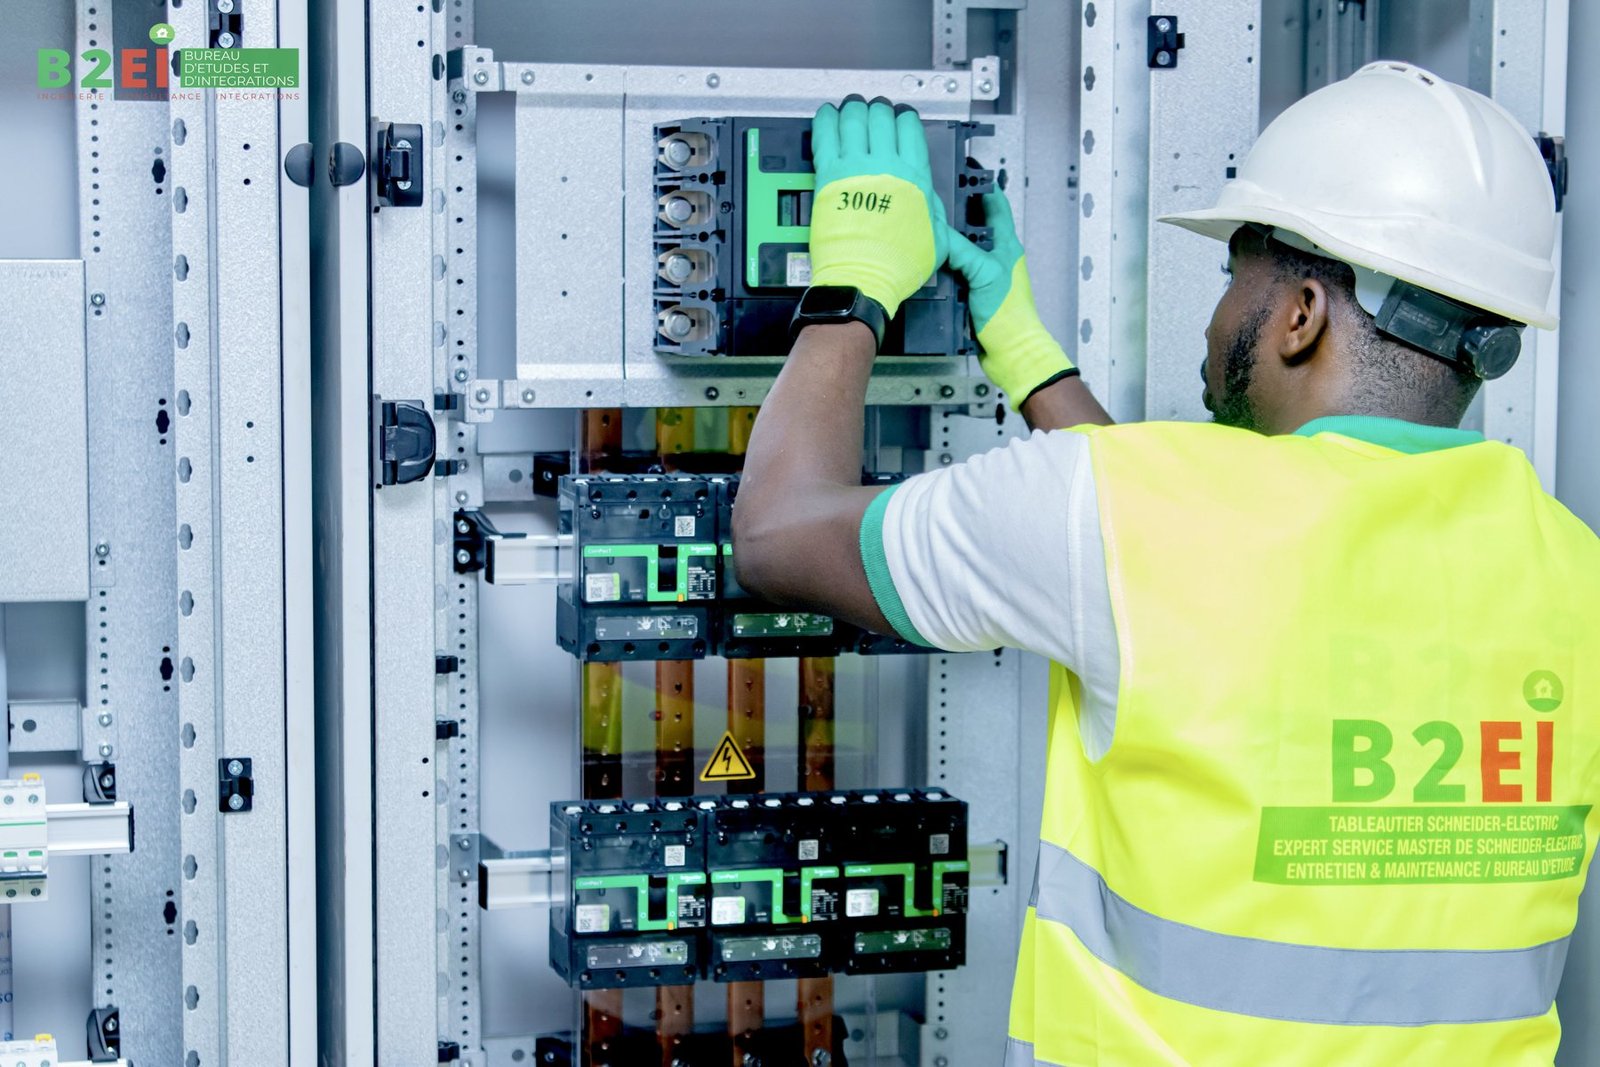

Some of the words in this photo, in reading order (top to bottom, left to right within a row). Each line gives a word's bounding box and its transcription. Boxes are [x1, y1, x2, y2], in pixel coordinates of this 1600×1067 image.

[837, 191, 892, 214] 300#
[1329, 816, 1423, 832] TABLEAUTIER
[1427, 815, 1559, 832] SCHNEIDER-ELECTRIC
[1273, 839, 1328, 856] EXPERT
[1332, 839, 1393, 856] SERVICE
[1397, 838, 1451, 856] MASTER
[1455, 838, 1473, 855] DE
[1476, 834, 1584, 855] SCHNEIDER-ELECTRIC
[1286, 862, 1366, 879] ENTRETIEN
[1369, 862, 1381, 879] &
[1384, 861, 1481, 879] MAINTENANCE
[1494, 859, 1539, 877] BUREAU
[1542, 856, 1576, 875] D'ETUDE
